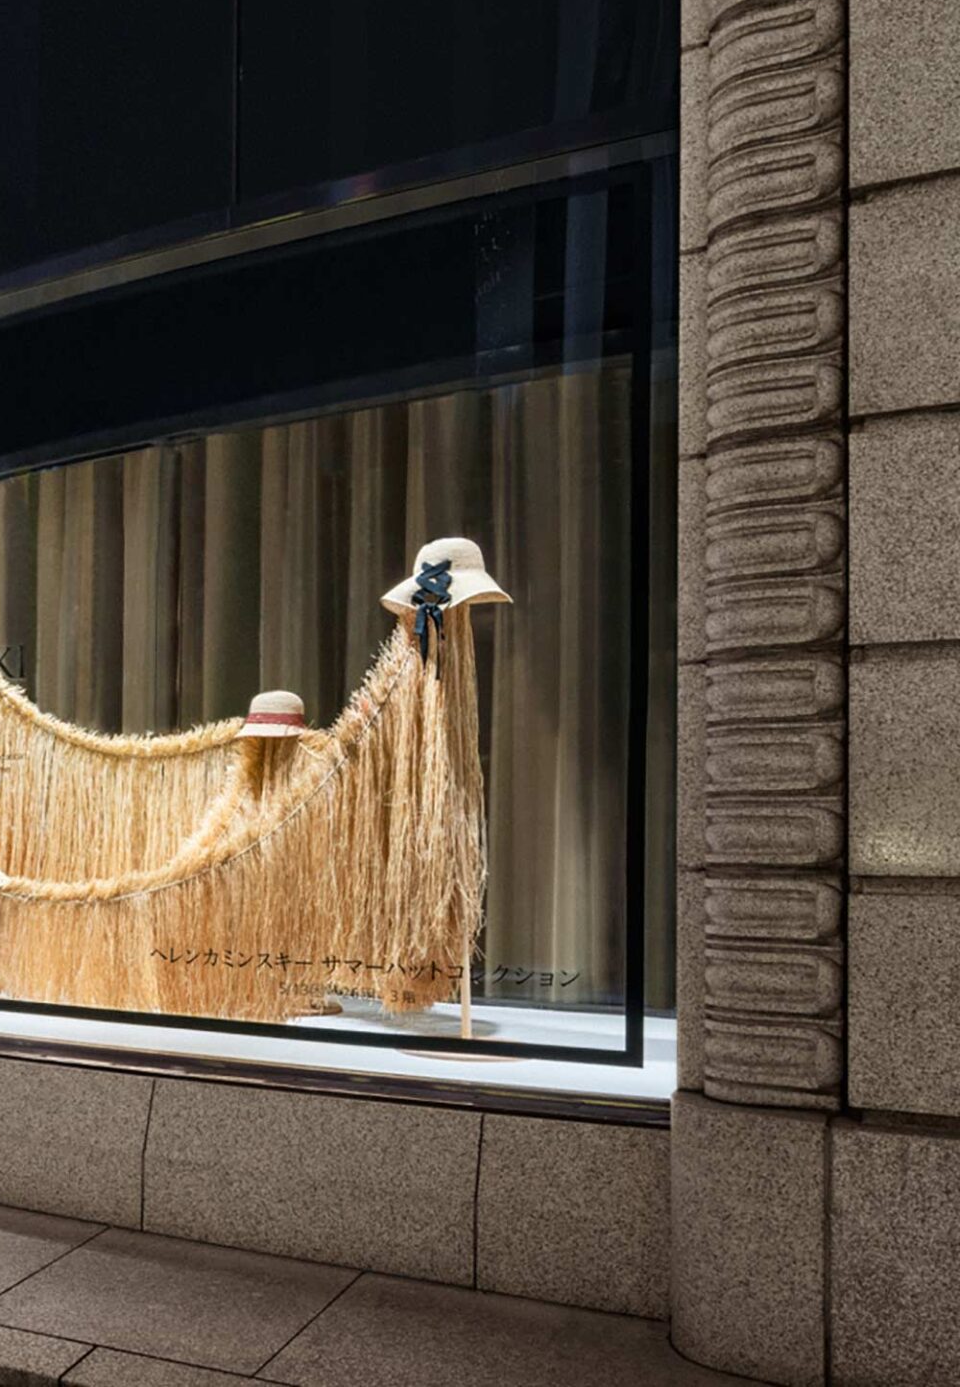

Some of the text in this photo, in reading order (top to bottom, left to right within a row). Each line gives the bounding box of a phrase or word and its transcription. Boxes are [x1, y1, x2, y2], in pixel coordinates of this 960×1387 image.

[150, 947, 314, 972] ヘレンカミンスキー
